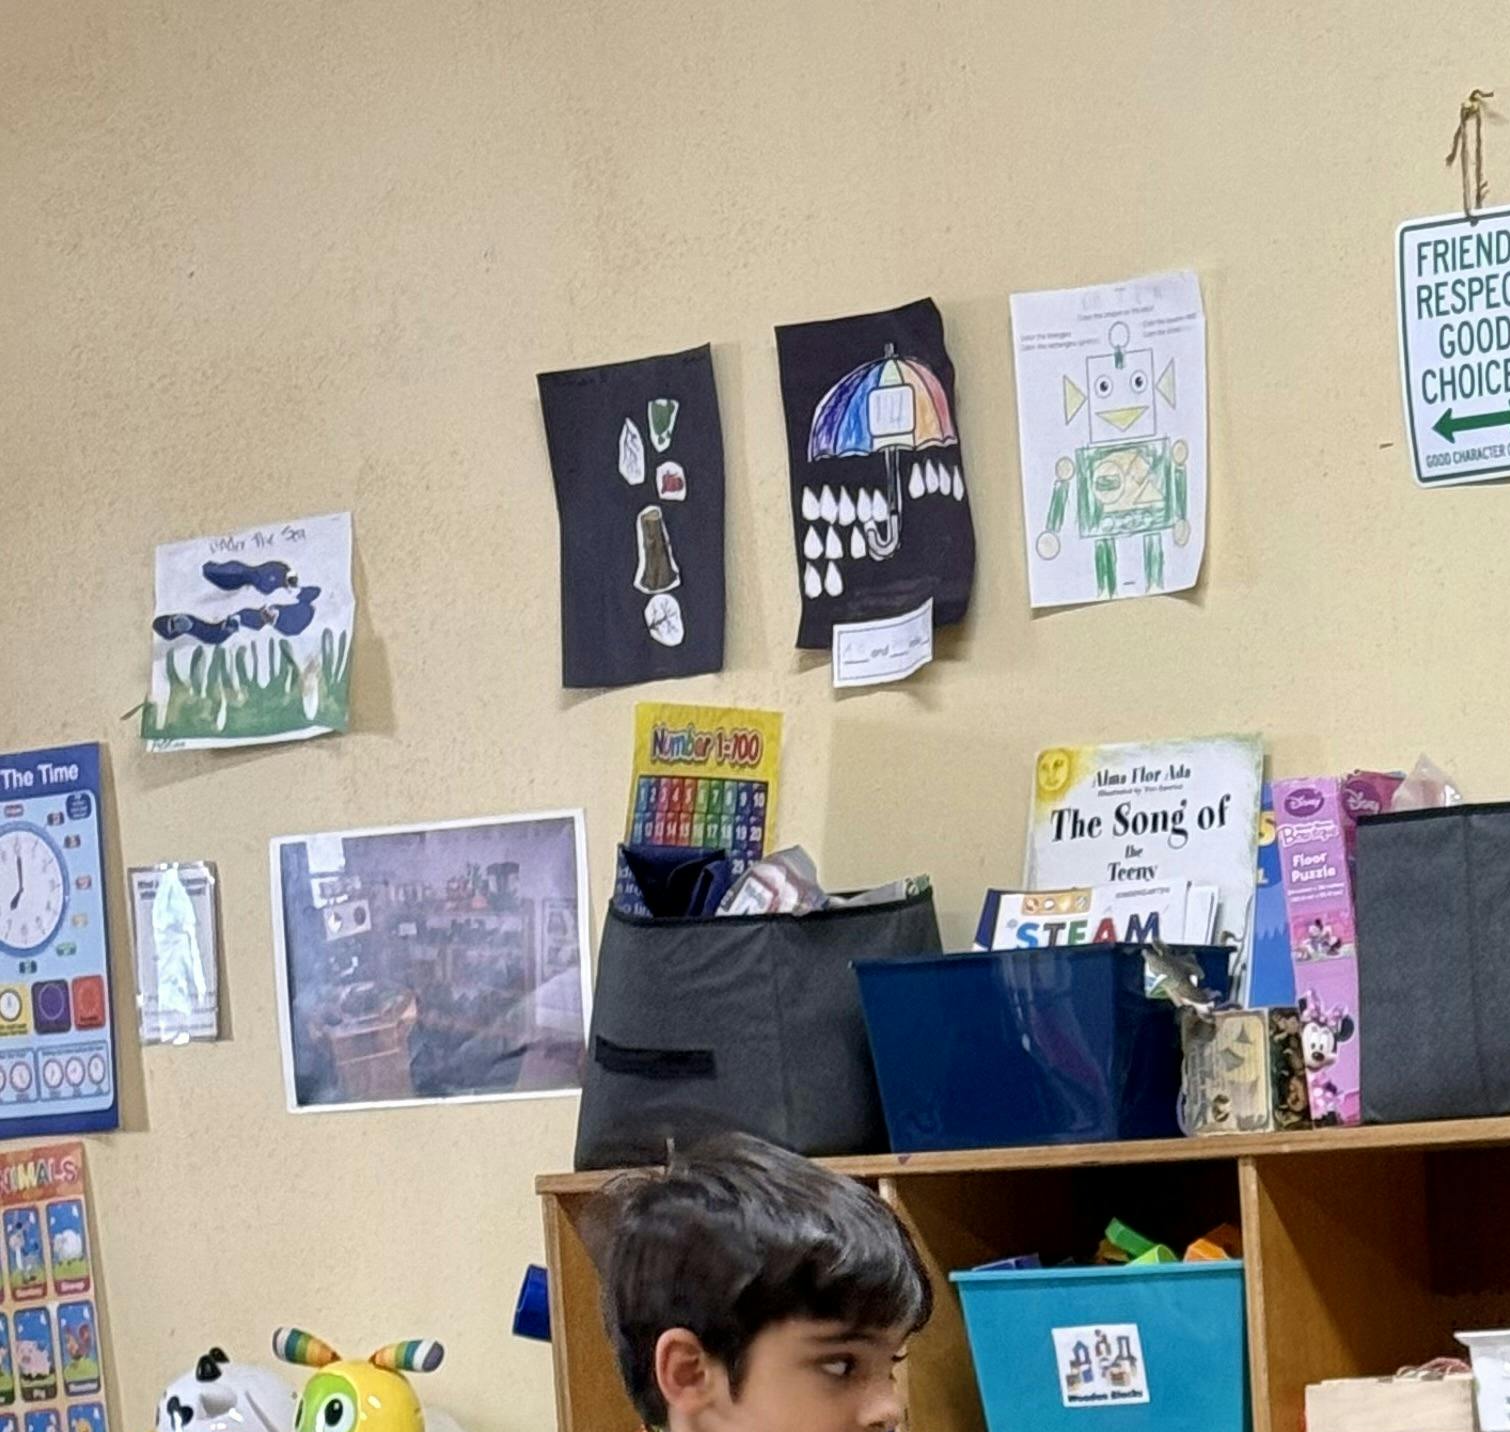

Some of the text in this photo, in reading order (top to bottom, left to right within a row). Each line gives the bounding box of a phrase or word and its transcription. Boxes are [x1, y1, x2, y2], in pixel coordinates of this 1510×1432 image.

[1425, 452, 1451, 468] GOOD
[1453, 444, 1506, 464] CHARACTER
[652, 723, 762, 765] Number 1-100
[0, 763, 79, 790] The Time
[1092, 768, 1127, 788] Alma
[1131, 765, 1161, 784] Flor
[1164, 763, 1191, 780] Ada
[672, 787, 679, 802] 4
[712, 789, 719, 804] 7
[753, 791, 765, 808] 10
[706, 822, 719, 839] 17
[735, 825, 747, 840] 19
[749, 826, 762, 841] 20
[1050, 808, 1102, 842] The
[1112, 799, 1189, 850] Song
[1197, 793, 1231, 831] of
[1124, 844, 1143, 859] the
[1292, 852, 1327, 867] Floor
[1107, 861, 1158, 882] Teeny
[1291, 864, 1336, 883] Puzzle
[1016, 911, 1160, 949] STEAM
